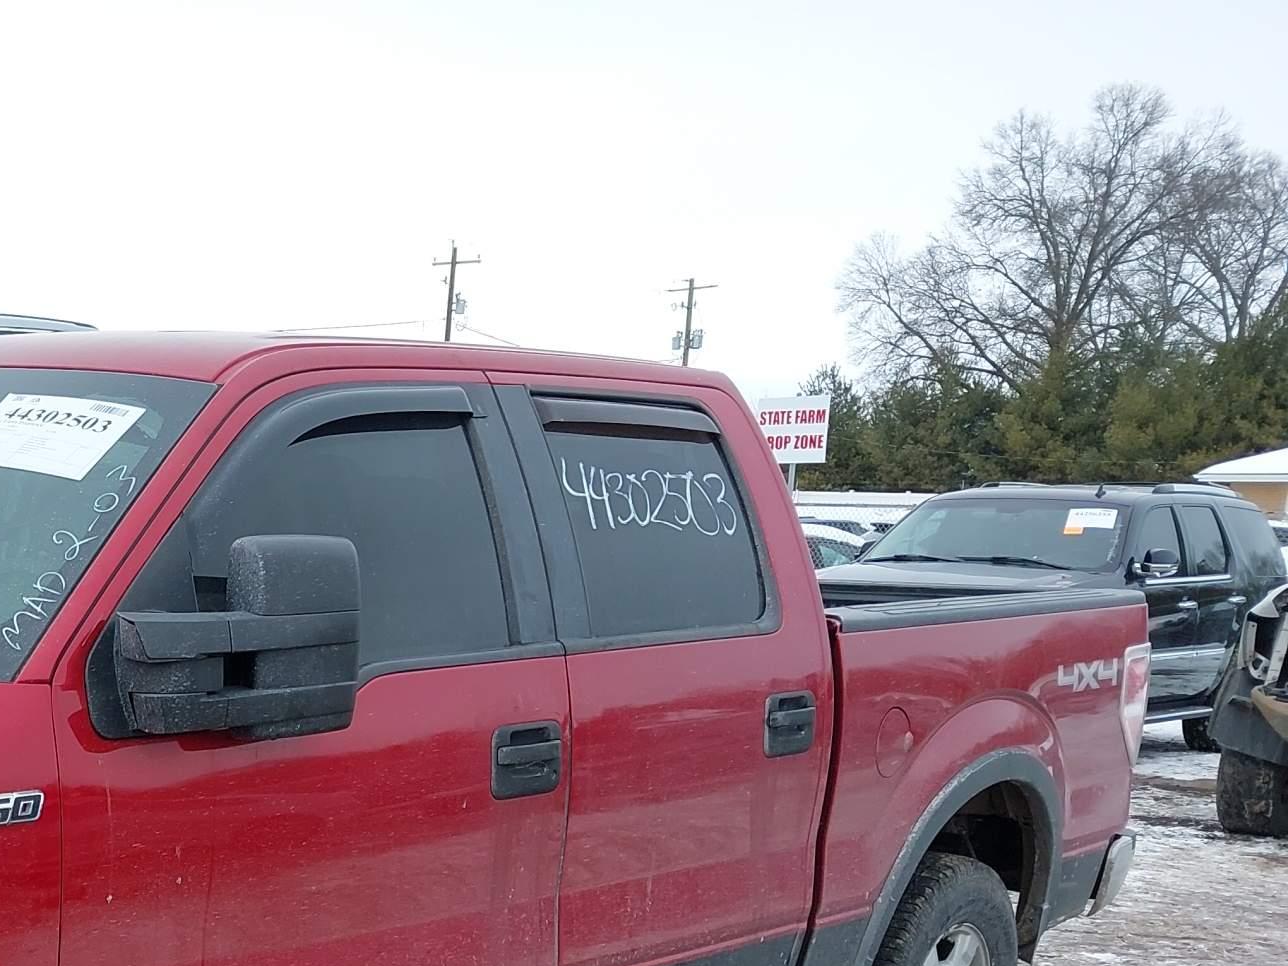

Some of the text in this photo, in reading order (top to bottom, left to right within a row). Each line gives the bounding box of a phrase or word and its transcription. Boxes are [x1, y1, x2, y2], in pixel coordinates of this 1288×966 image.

[5, 407, 112, 432] 44302503
[759, 409, 826, 426] STATE FARM
[767, 434, 824, 450] ROP ZONE
[561, 456, 737, 535] 44302503
